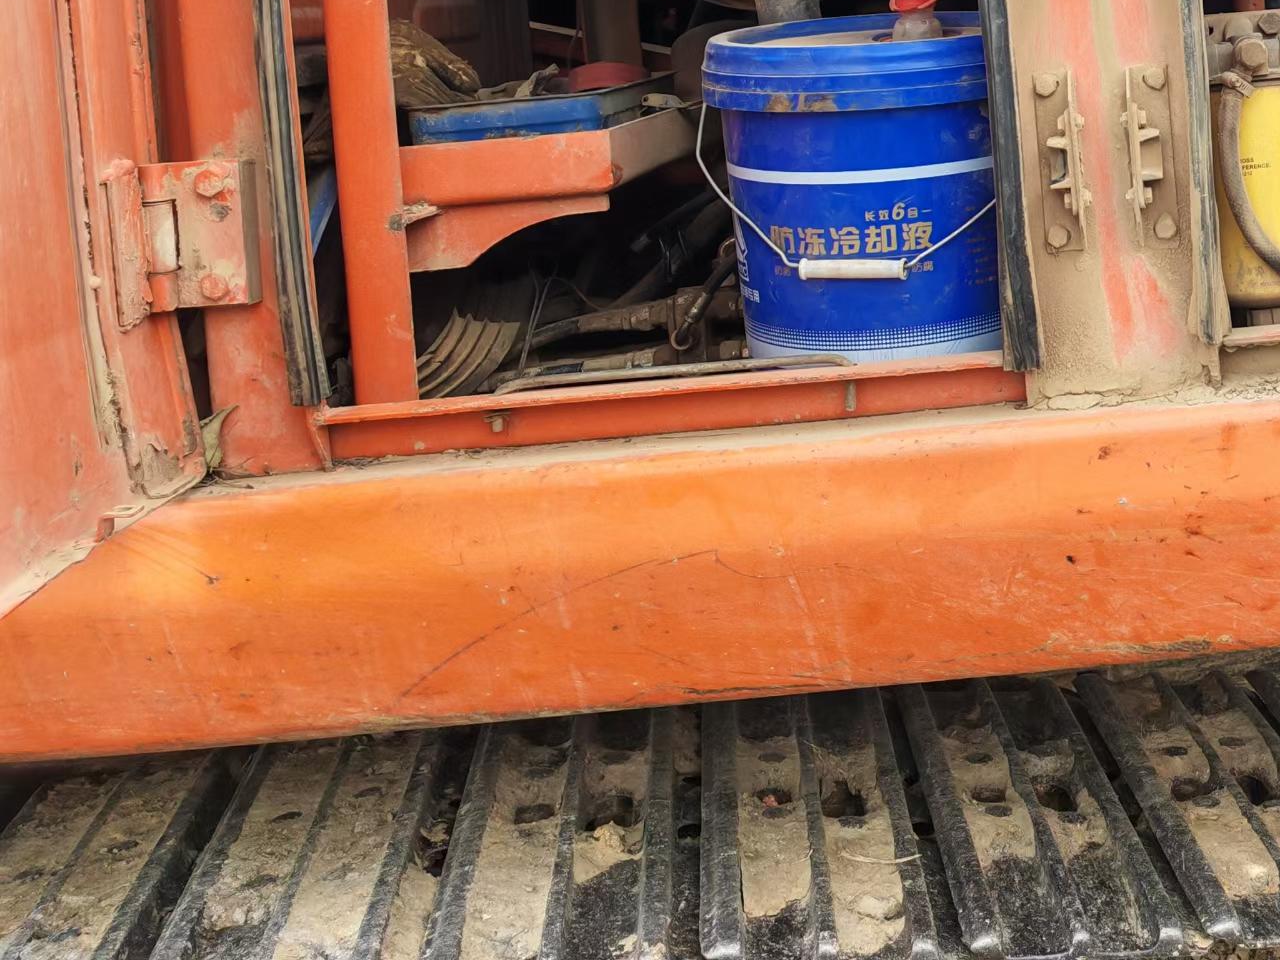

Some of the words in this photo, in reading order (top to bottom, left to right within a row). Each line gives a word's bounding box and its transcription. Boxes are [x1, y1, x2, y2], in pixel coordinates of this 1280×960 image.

[770, 221, 933, 256] 防冻冷却液
